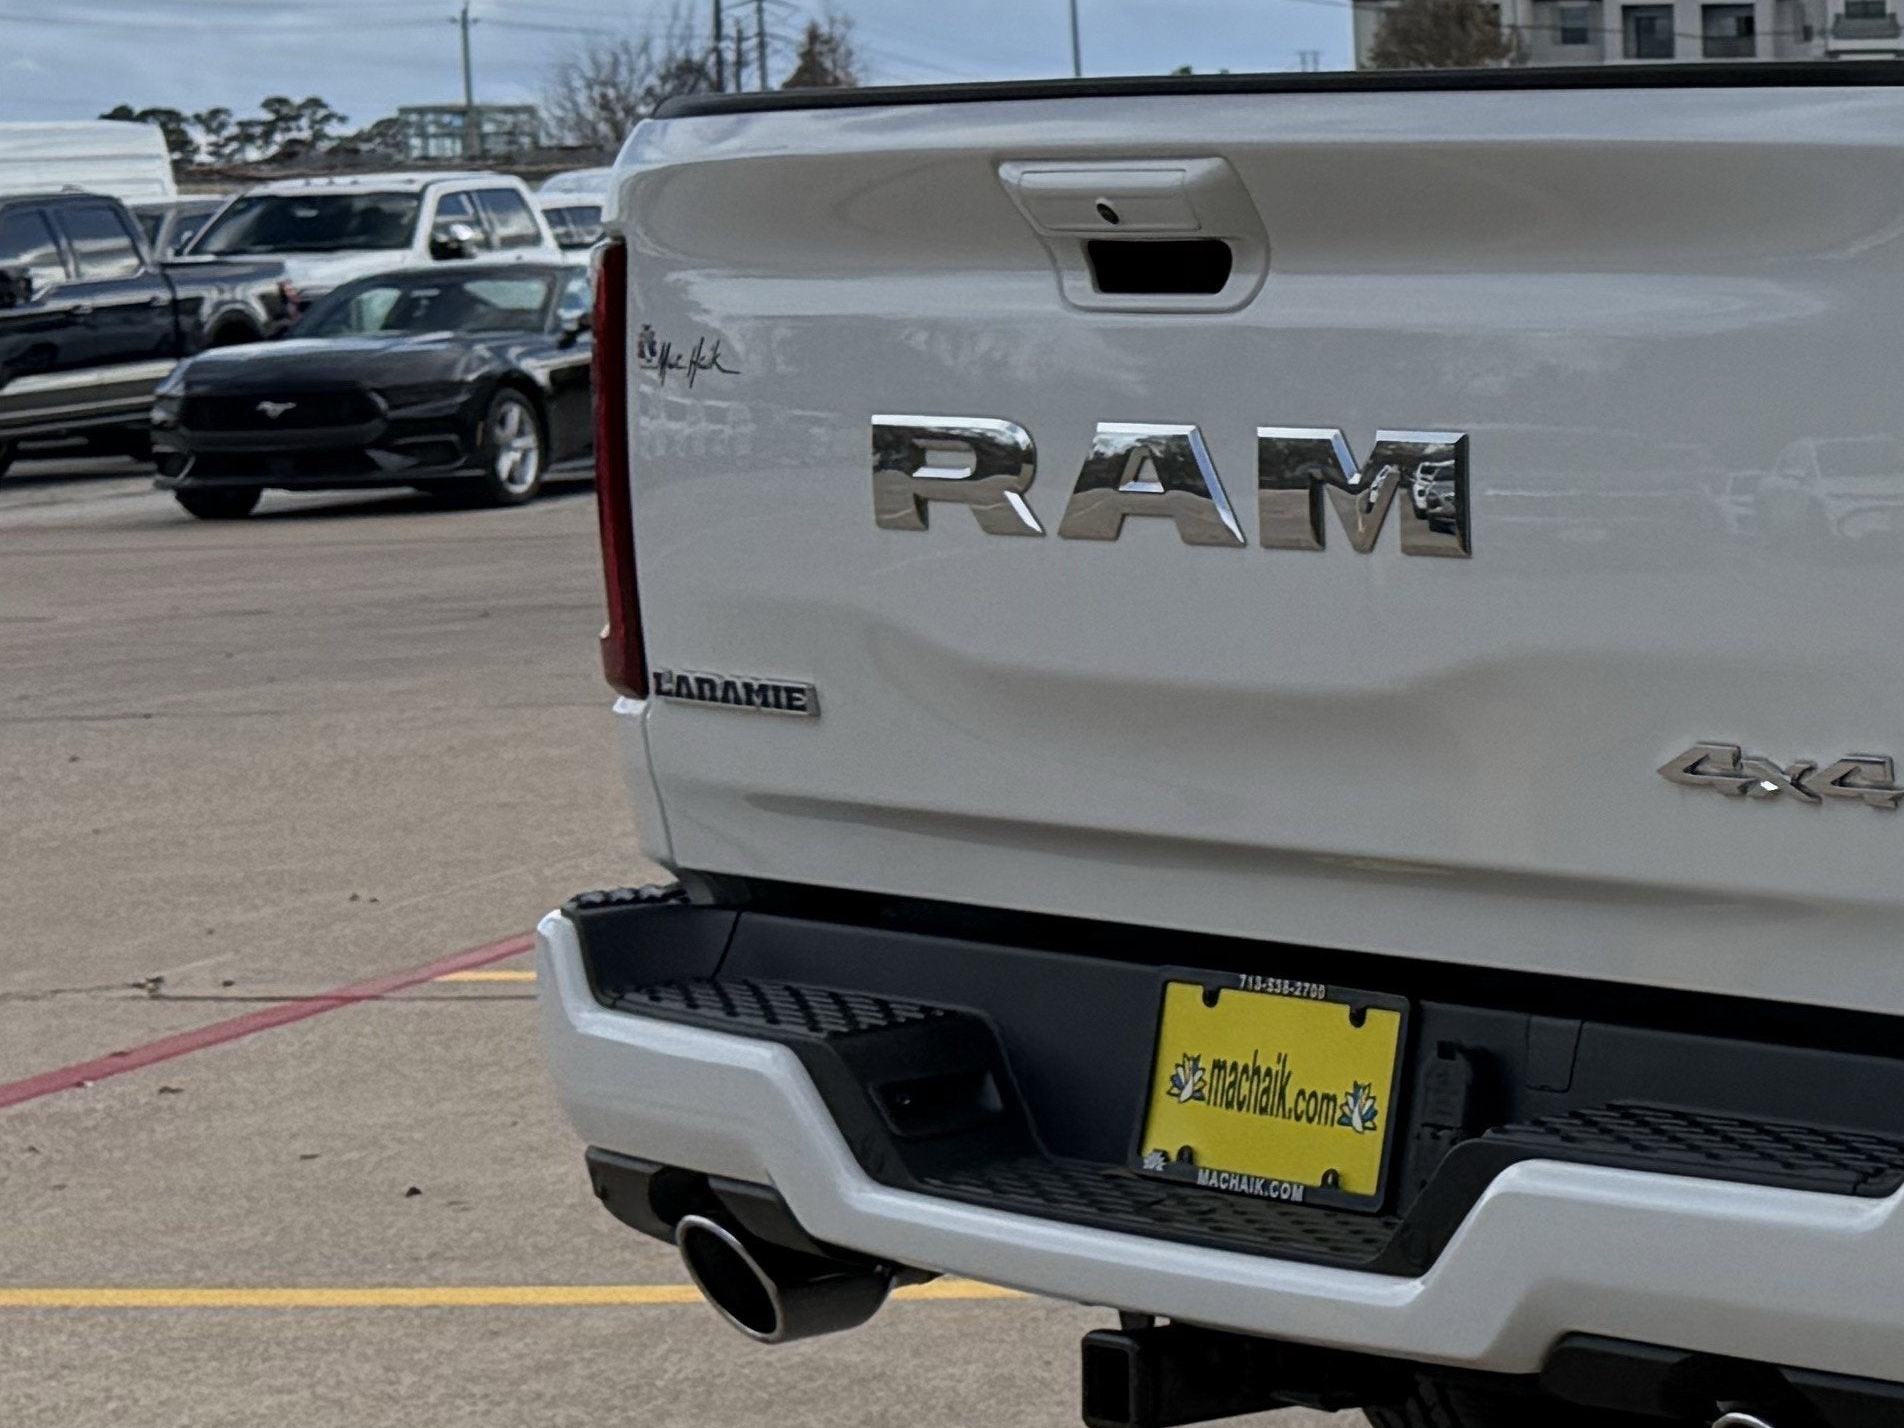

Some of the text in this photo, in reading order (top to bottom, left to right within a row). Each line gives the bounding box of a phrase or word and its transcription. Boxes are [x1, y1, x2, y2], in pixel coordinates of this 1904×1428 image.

[871, 414, 1472, 557] RAM
[652, 669, 809, 713] LARAMIE
[1206, 1049, 1338, 1127] machaik.com
[1197, 1169, 1304, 1202] MACHAIK.COM
